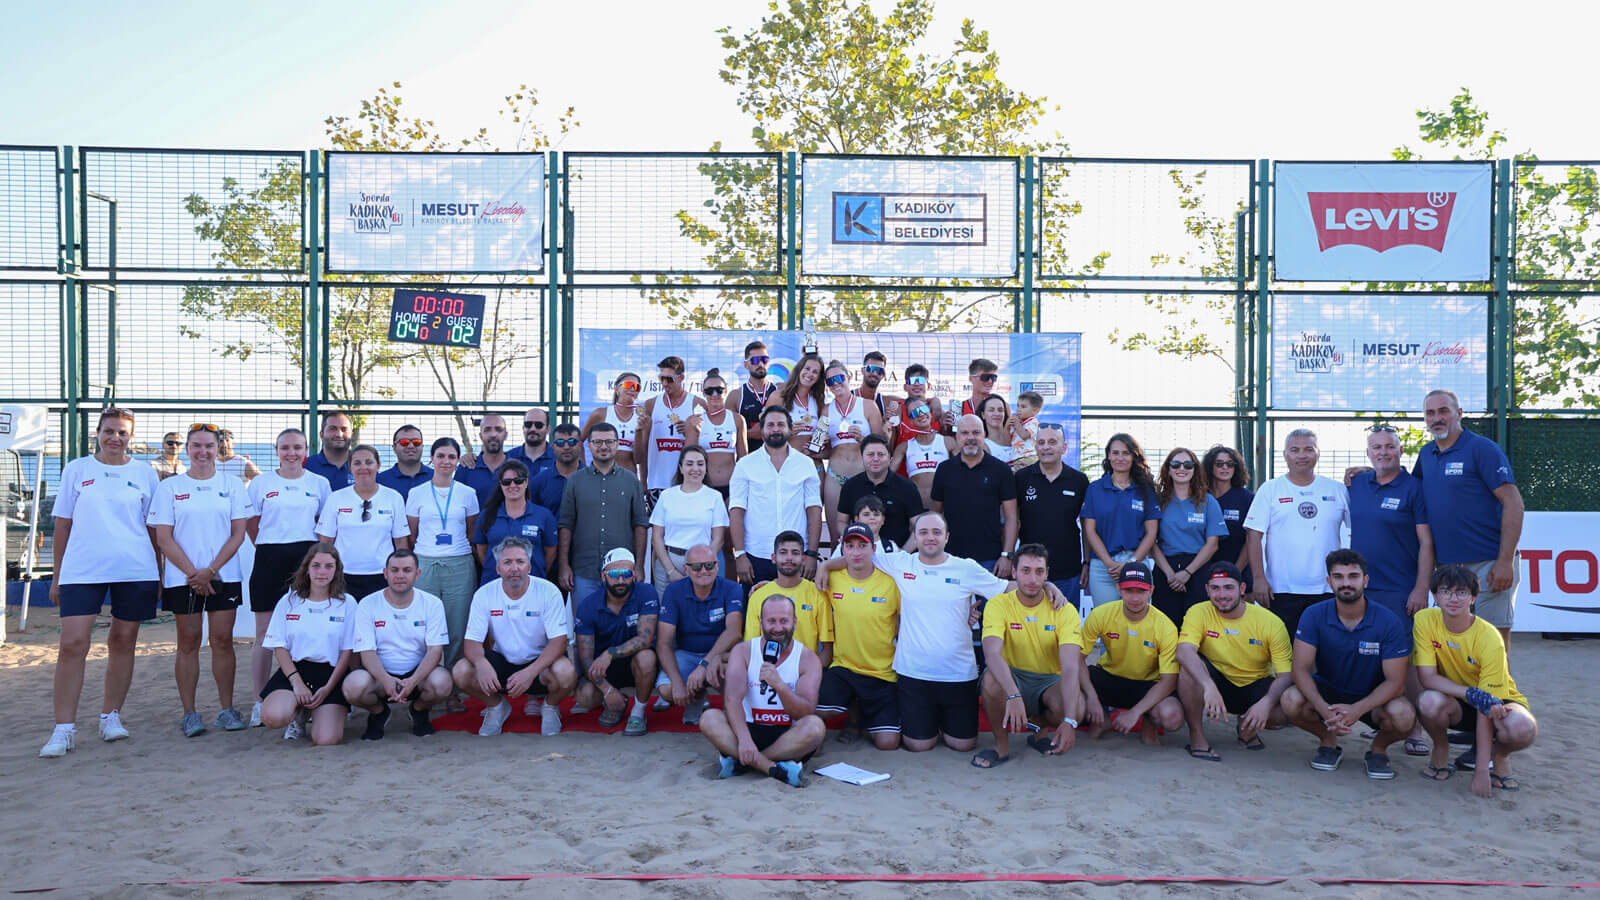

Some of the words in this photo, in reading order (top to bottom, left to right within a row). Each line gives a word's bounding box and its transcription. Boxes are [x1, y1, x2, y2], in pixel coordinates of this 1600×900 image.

[349, 203, 395, 219] KADIKÖY
[421, 203, 479, 216] MESUT
[894, 200, 956, 214] KADIKÖY
[358, 218, 386, 231] BAŞKA
[894, 224, 975, 238] BELEDİYESİ
[413, 295, 465, 317] 00:00
[395, 311, 428, 324] HOME
[432, 315, 442, 329] 2
[446, 315, 479, 328] GUEST
[396, 321, 420, 339] 04
[419, 326, 429, 340] 0
[451, 325, 474, 344] 02
[1291, 343, 1336, 359] KADIKÖY
[1362, 343, 1421, 356] MESUT
[1299, 358, 1327, 371] BAŞKA
[668, 424, 674, 436] 1
[716, 432, 723, 441] 2
[924, 452, 929, 461] 1
[1519, 550, 1599, 594] TO
[767, 688, 778, 705] 2
